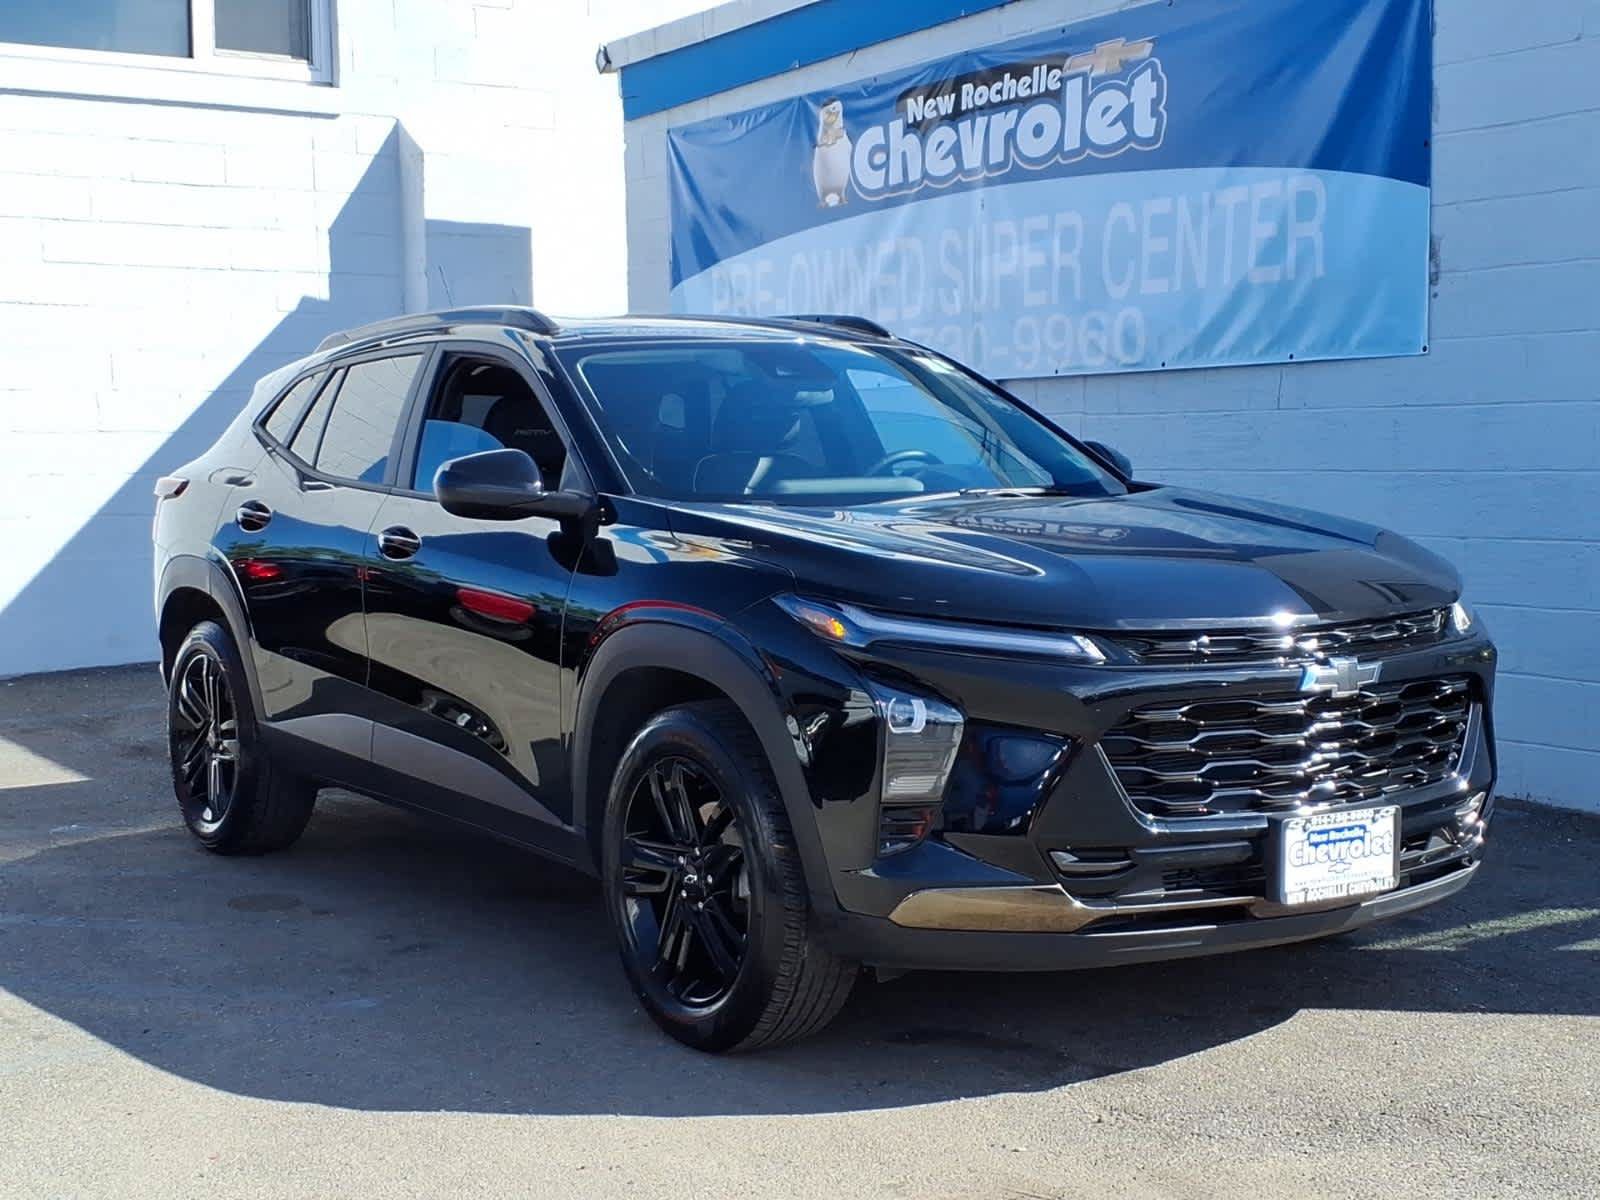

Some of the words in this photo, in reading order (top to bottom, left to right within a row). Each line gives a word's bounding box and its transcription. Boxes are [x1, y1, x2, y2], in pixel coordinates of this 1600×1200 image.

[852, 66, 1161, 192] Chevrolet
[907, 94, 956, 125] New
[961, 65, 1062, 111] Rochelle
[711, 236, 927, 321] PRE-OWNED
[937, 210, 1084, 317] SUPER
[1101, 174, 1328, 299] CENTER
[1288, 831, 1393, 867] Chevrolet
